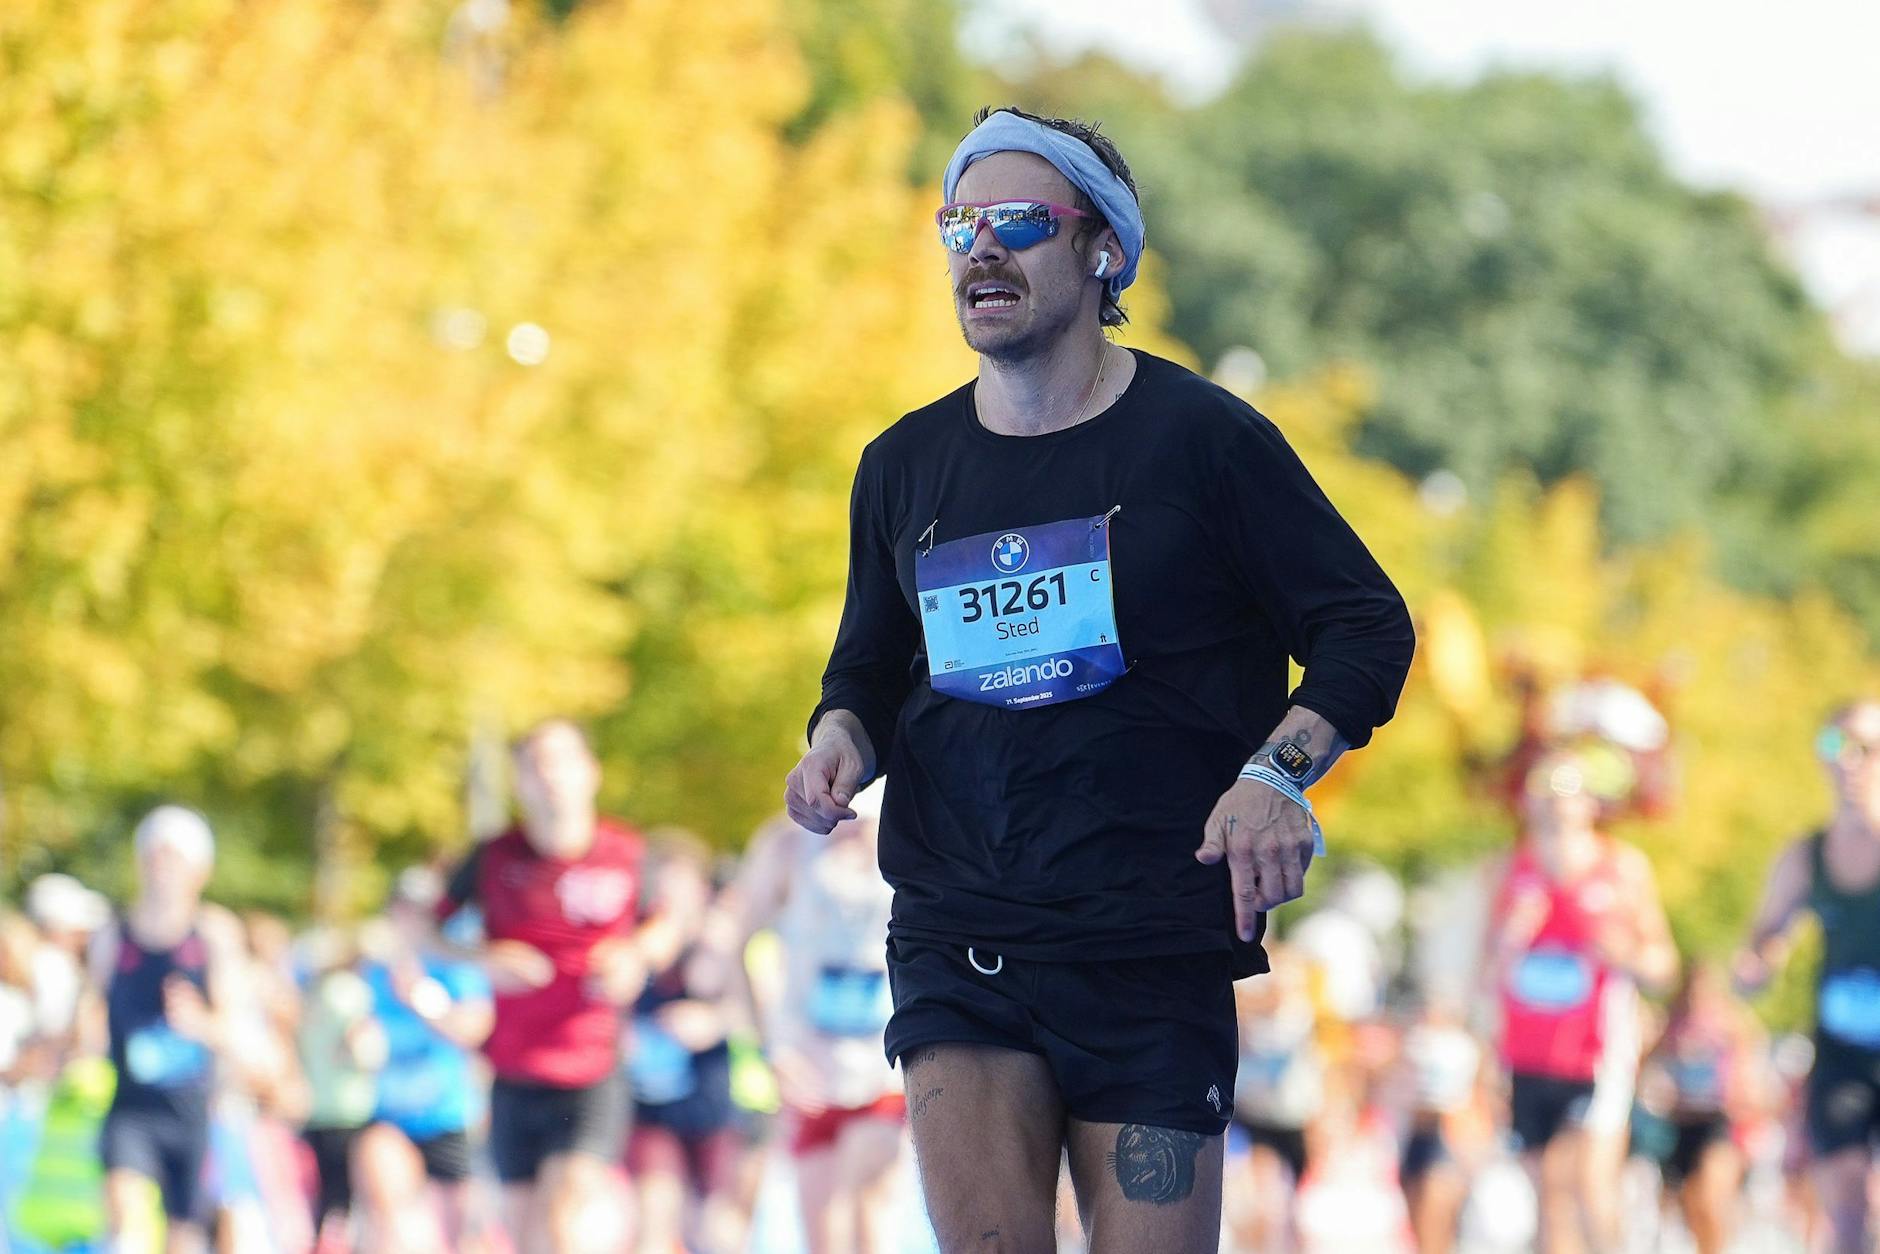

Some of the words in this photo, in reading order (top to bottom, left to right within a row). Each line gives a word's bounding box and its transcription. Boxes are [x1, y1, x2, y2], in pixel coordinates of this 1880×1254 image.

[996, 536, 1024, 549] BMW
[1090, 569, 1100, 582] C
[959, 571, 1067, 623] 31261
[996, 616, 1040, 640] Sted
[979, 658, 1073, 691] zalando
